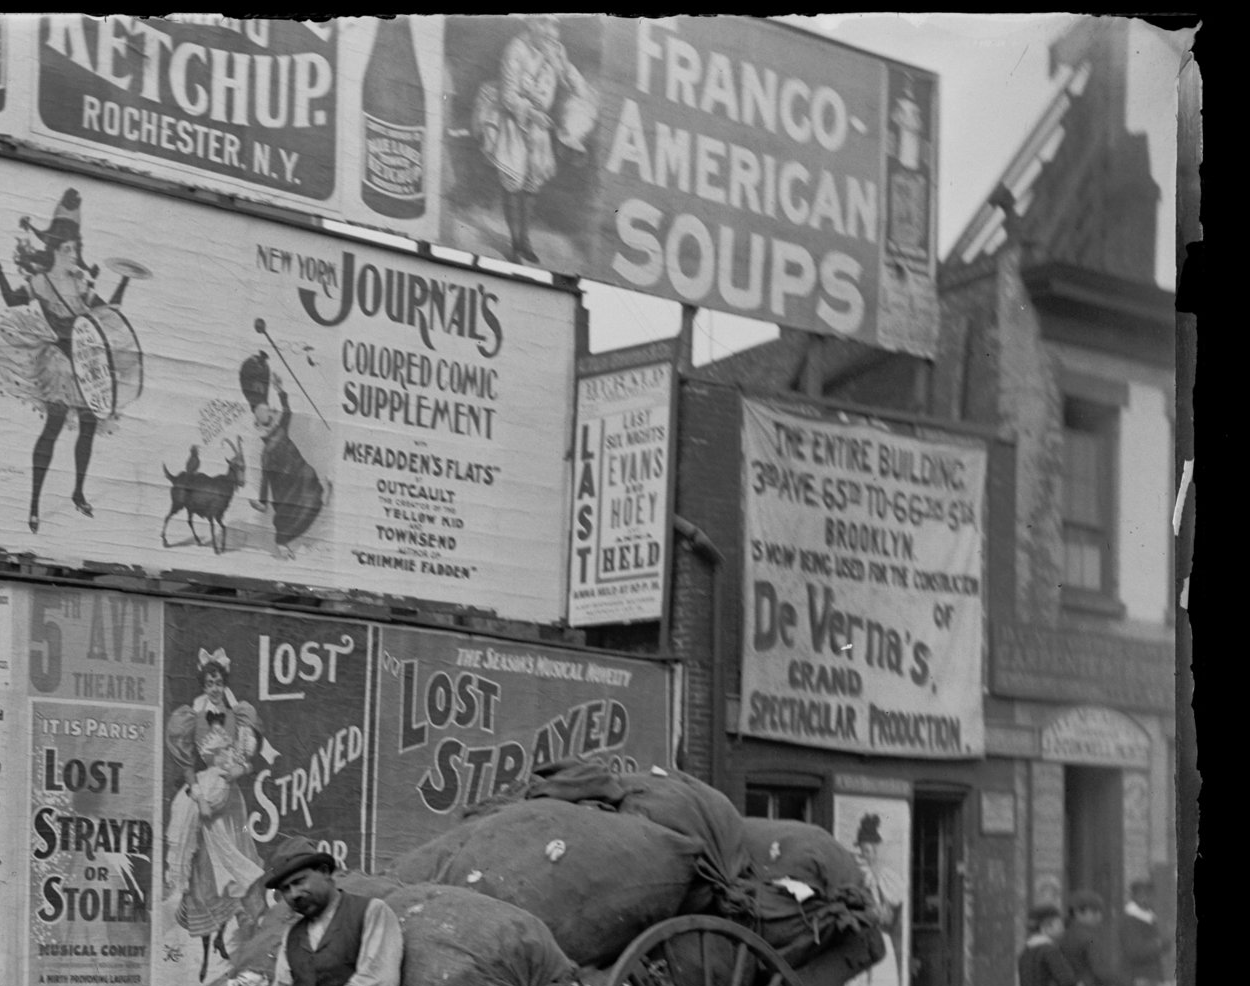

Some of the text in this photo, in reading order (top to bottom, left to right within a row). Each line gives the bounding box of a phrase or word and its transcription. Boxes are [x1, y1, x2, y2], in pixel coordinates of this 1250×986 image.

[46, 13, 332, 129] KETCHUP.
[636, 17, 867, 151] FRANCO-
[253, 141, 301, 185] N.Y.
[606, 98, 877, 243] AMERICAN
[255, 244, 339, 299] NEW YORK
[611, 198, 865, 334] SOUPS
[298, 250, 503, 359] JOURNAL'S
[342, 339, 499, 401] COLORED COMIC
[341, 380, 497, 440] SUPPLEMENT
[607, 446, 666, 488] EVANS
[810, 429, 873, 475] ENTIRE
[878, 442, 966, 494] BUILDING
[376, 478, 456, 503] OUTCAULT
[575, 423, 597, 585] LAST
[609, 492, 658, 530] HOEY
[375, 524, 457, 552] TOWNSEND
[383, 506, 464, 530] YELLOW KID
[824, 516, 916, 561] BROOKLYN
[602, 541, 661, 573] HELD
[753, 580, 798, 652] De
[72, 671, 146, 701] THEATRE
[258, 633, 356, 701] LOST
[787, 659, 863, 698] GRAND
[64, 718, 83, 737] IS
[749, 690, 859, 742] SPECTACULAR
[44, 747, 124, 794] LOST
[415, 699, 630, 814] STRAYED
[250, 725, 363, 843] STRAYED
[33, 806, 153, 862] STRAYED
[37, 875, 149, 923] STOLEN
[83, 866, 109, 882] OR
[38, 944, 147, 957] MUSICAL COMEDY
